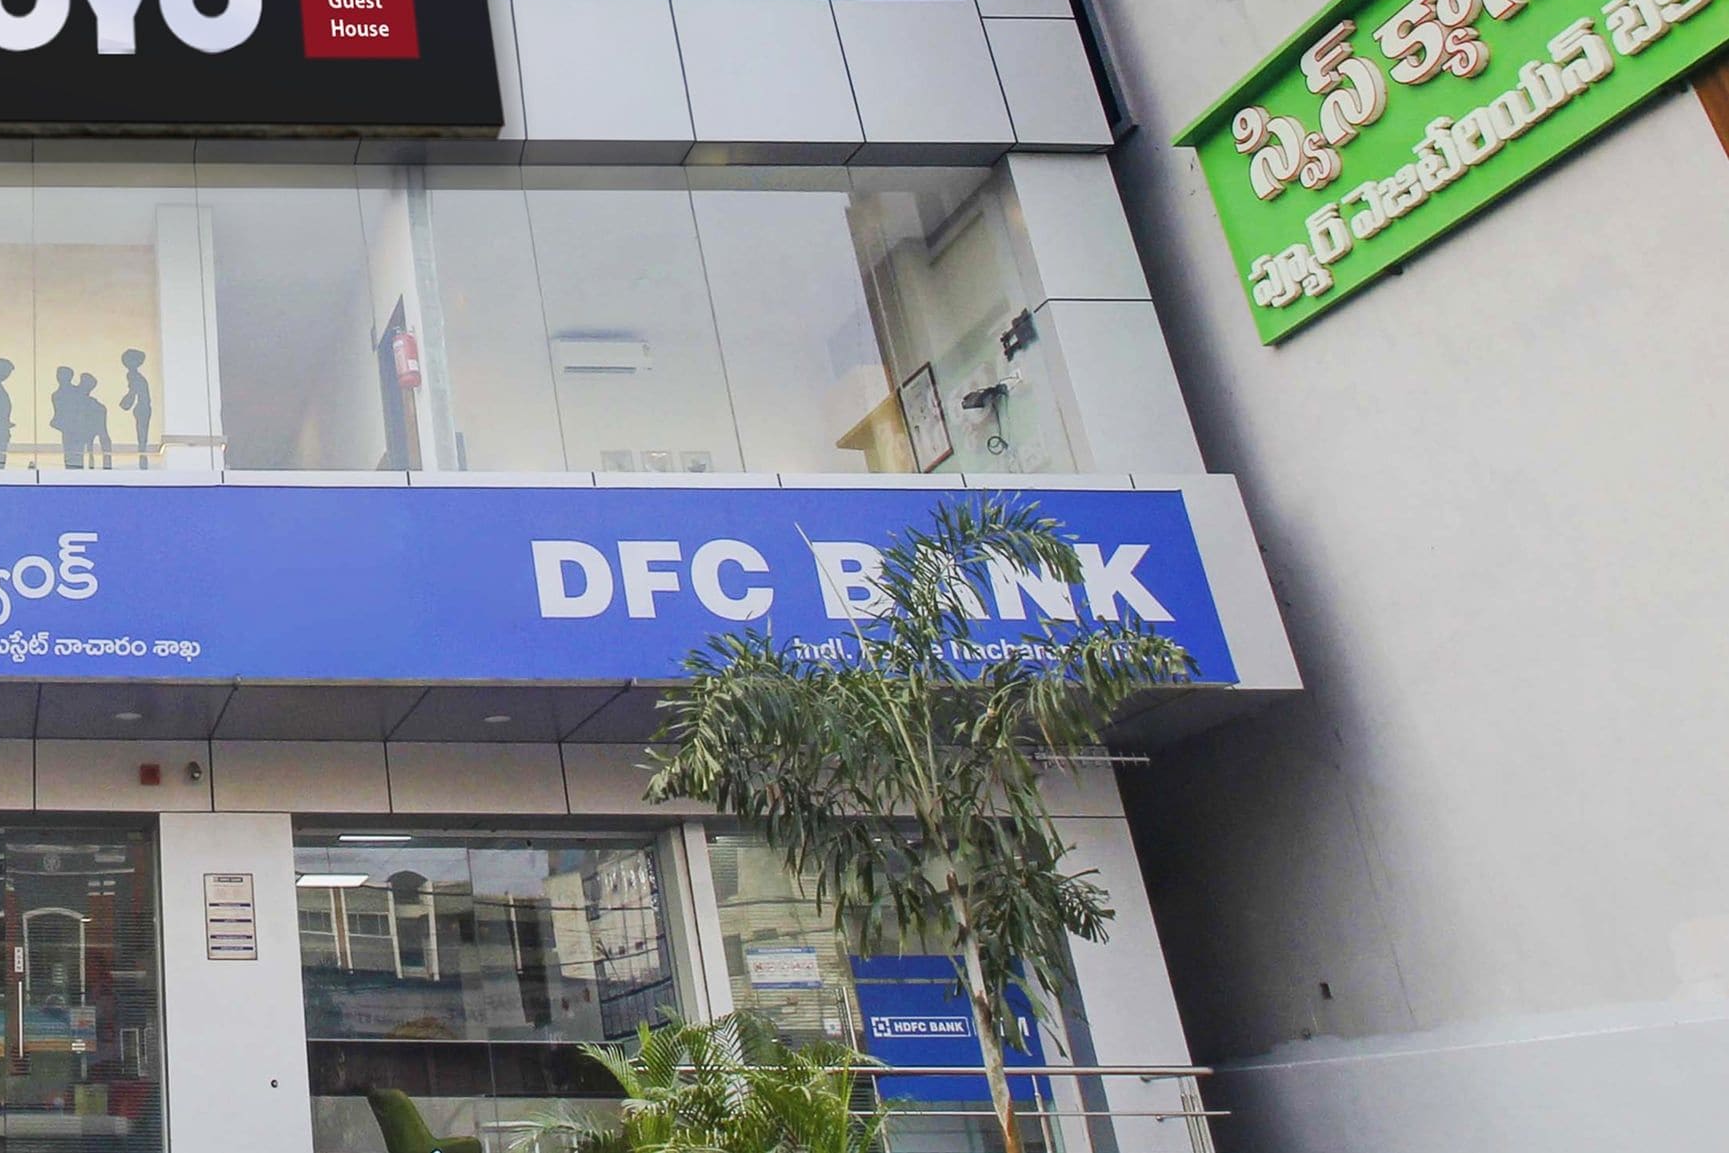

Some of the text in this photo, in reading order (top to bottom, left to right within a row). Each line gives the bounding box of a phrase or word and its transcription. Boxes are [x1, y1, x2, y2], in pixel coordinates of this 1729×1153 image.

[330, 18, 390, 39] House
[530, 538, 1177, 622] DFC BANK
[893, 1019, 927, 1034] HDFC
[930, 1019, 965, 1034] BANK
